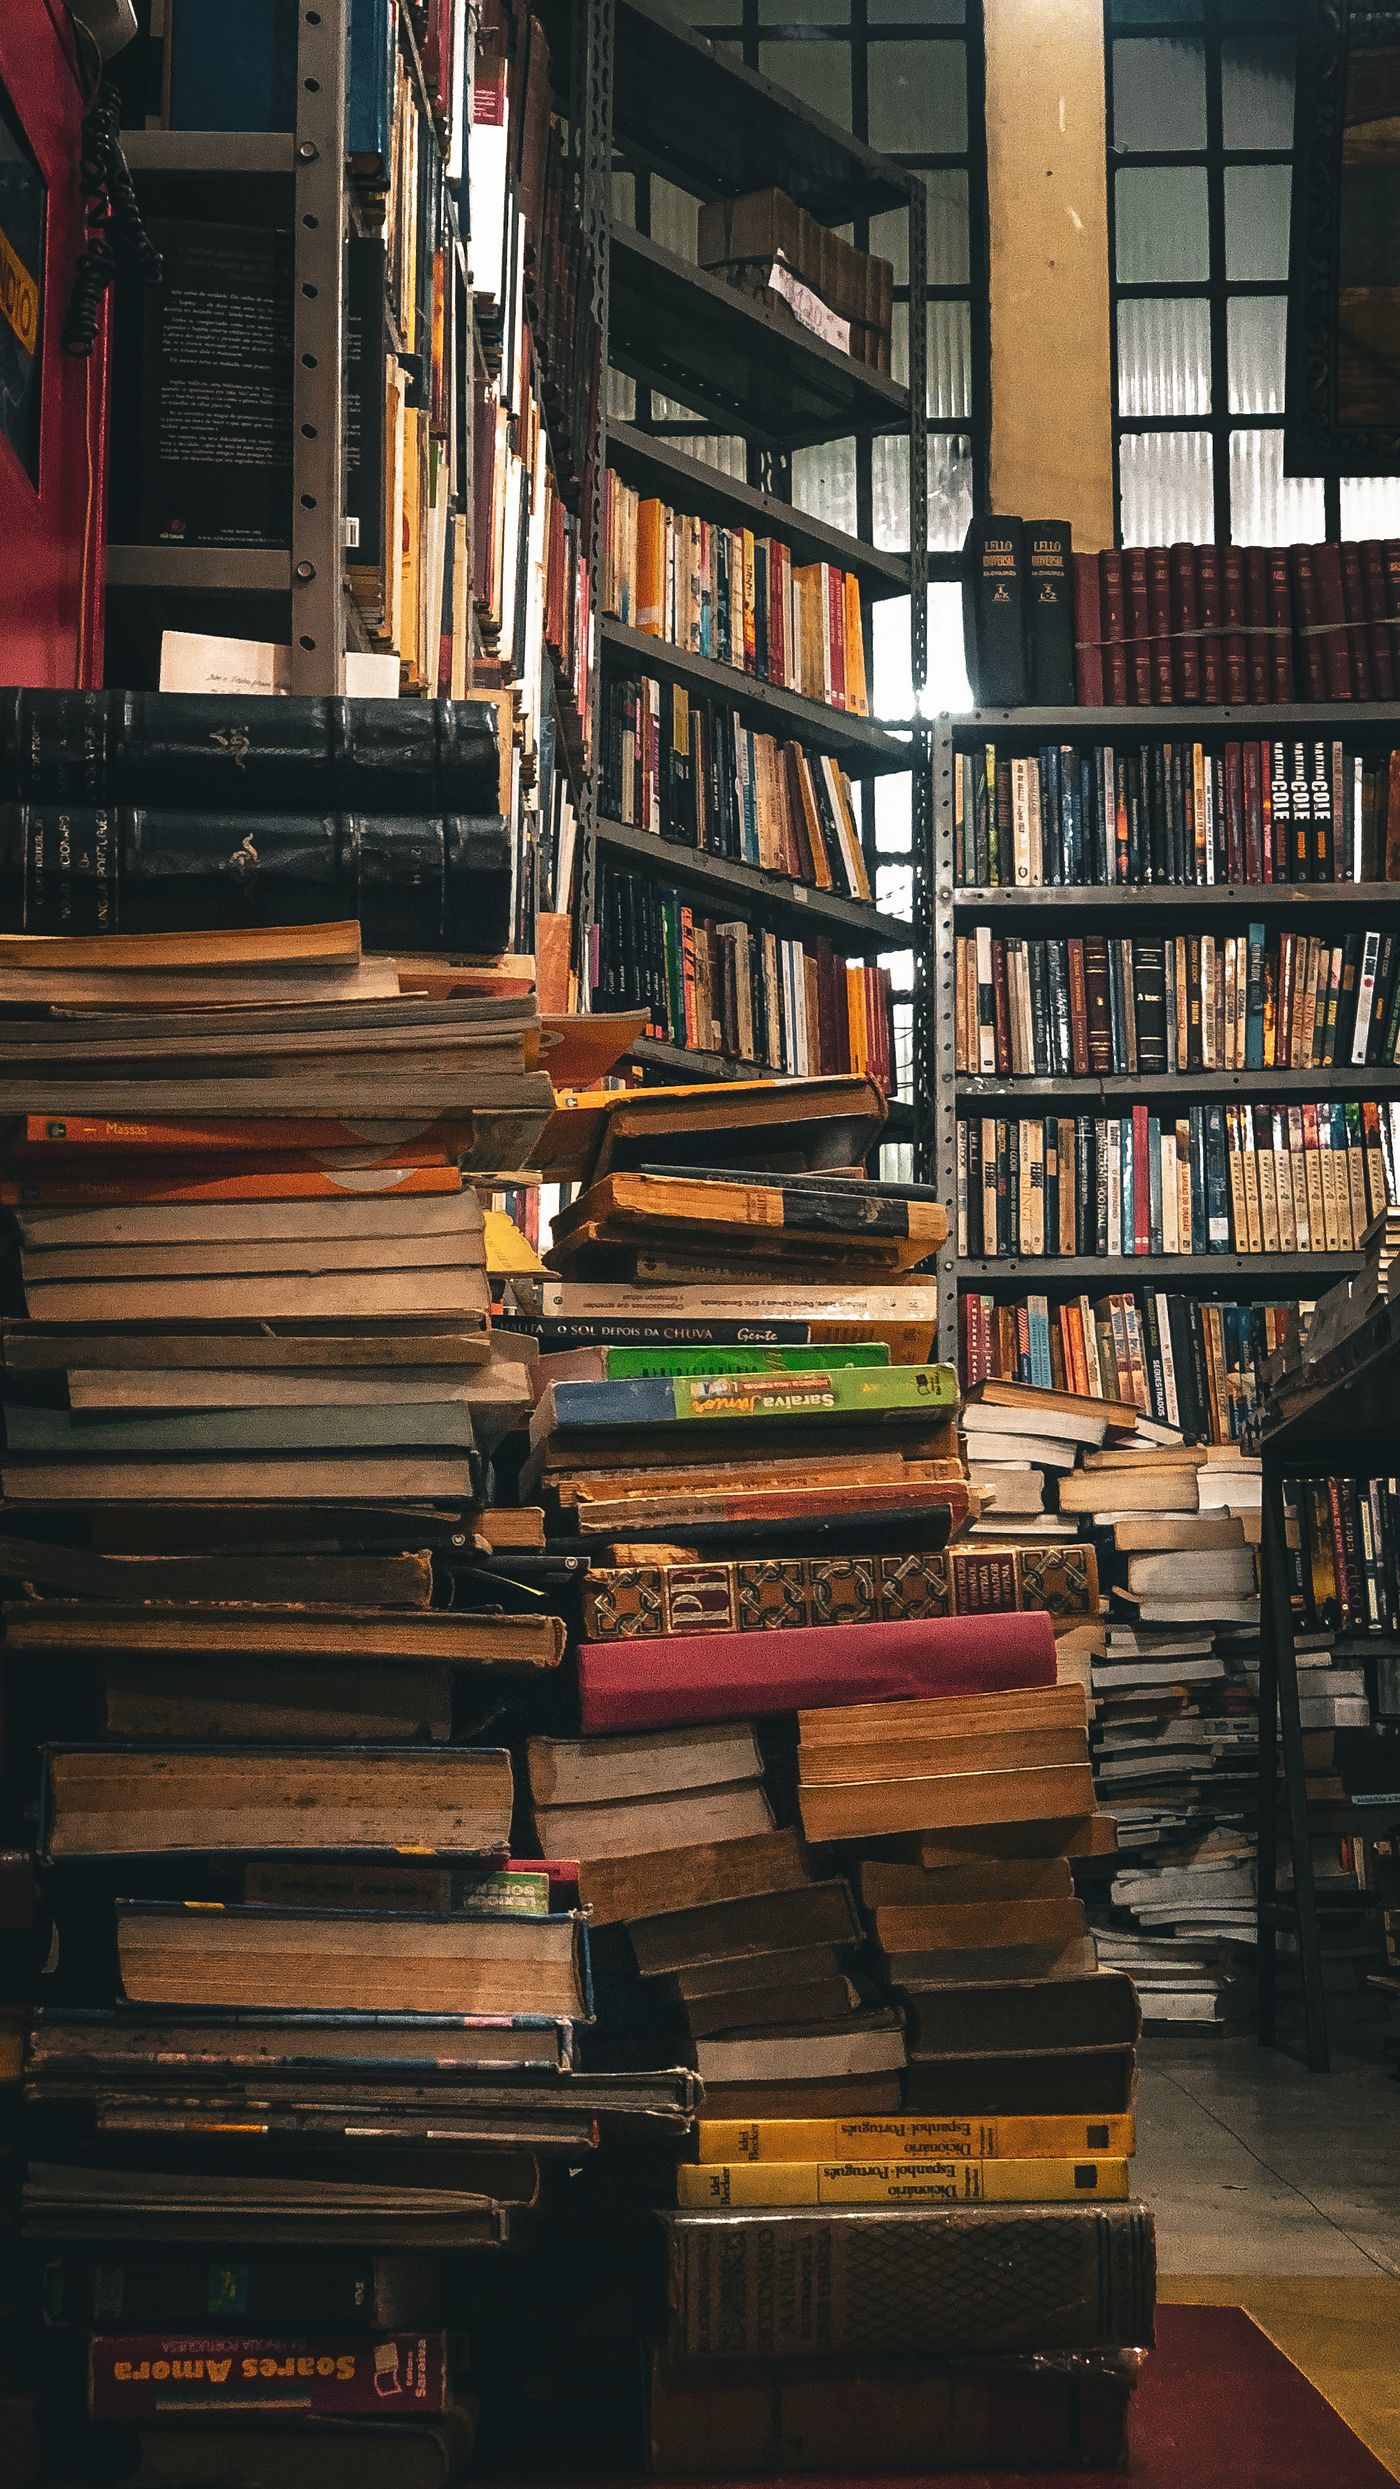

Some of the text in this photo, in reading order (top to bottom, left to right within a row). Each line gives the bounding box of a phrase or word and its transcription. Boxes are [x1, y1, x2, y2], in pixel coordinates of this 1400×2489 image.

[985, 541, 1012, 552] LELLO
[1034, 541, 1061, 552] LELLO
[1274, 742, 1284, 780] MARTINA
[1294, 742, 1304, 780] MARTINA
[1314, 742, 1325, 780] MARTINA
[1271, 781, 1289, 820] COLE
[1291, 781, 1310, 820] COLE
[1311, 781, 1331, 820] COLE
[1249, 944, 1263, 982] ROBIN COOK
[1237, 989, 1245, 1020] COMA
[105, 1122, 147, 1135] Massas
[1009, 1125, 1018, 1149] ROBIN
[1010, 1150, 1019, 1172] COOK
[1030, 1162, 1042, 1188] FEBRE
[1098, 1186, 1107, 1203] VOO
[1098, 1205, 1107, 1229] FINAL
[557, 1326, 567, 1334] O
[570, 1326, 597, 1336] SOL
[601, 1327, 640, 1337] DEPOIS
[644, 1327, 659, 1337] DA
[664, 1327, 713, 1339] CHUVA
[737, 1328, 778, 1341] Gente
[763, 1393, 835, 1409] Saraiva
[1152, 1360, 1165, 1416] SEQUESTRADOS
[979, 1565, 990, 1604] ORTEGA
[990, 1563, 1000, 1603] AMADOR
[904, 2142, 971, 2156] Dicionário
[887, 2184, 957, 2198] Dicionário
[160, 2340, 240, 2353] PORTUGUESA
[113, 2355, 357, 2383] Soares Amora
[414, 2339, 426, 2398] Saraiva
